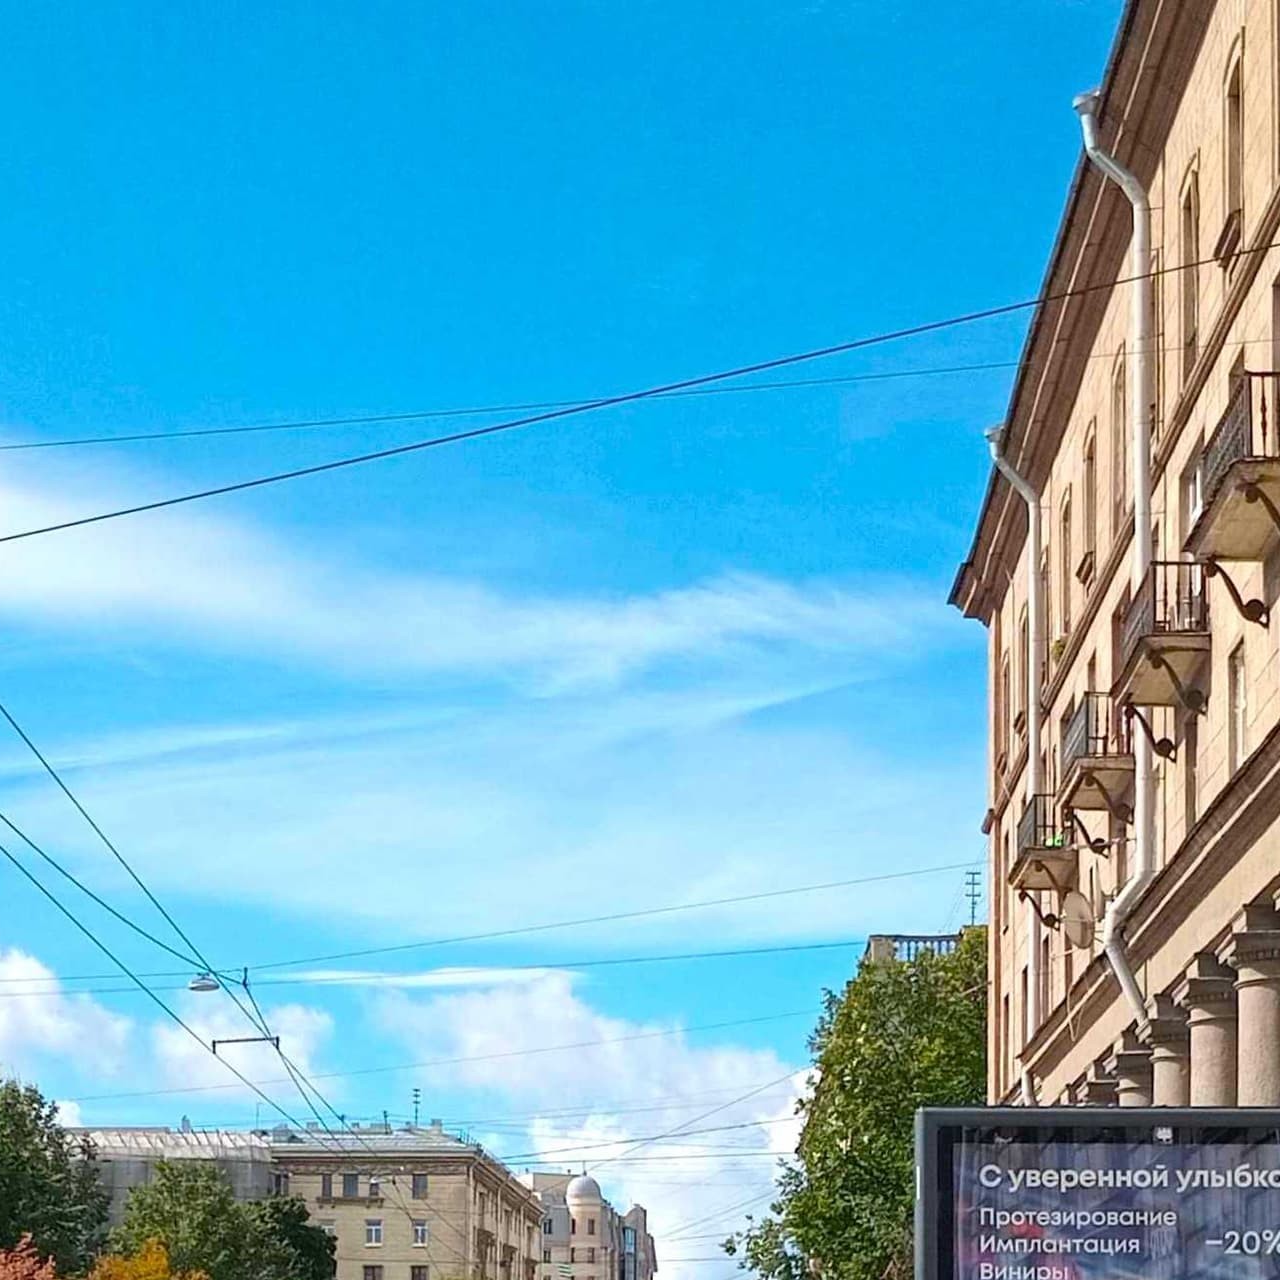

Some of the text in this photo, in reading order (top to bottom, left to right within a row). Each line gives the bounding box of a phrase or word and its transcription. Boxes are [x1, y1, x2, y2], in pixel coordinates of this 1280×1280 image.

[979, 1164, 1002, 1188] С
[1008, 1164, 1169, 1195] уверенной
[979, 1207, 1177, 1230] Протезирование
[979, 1235, 1140, 1257] Имплантация
